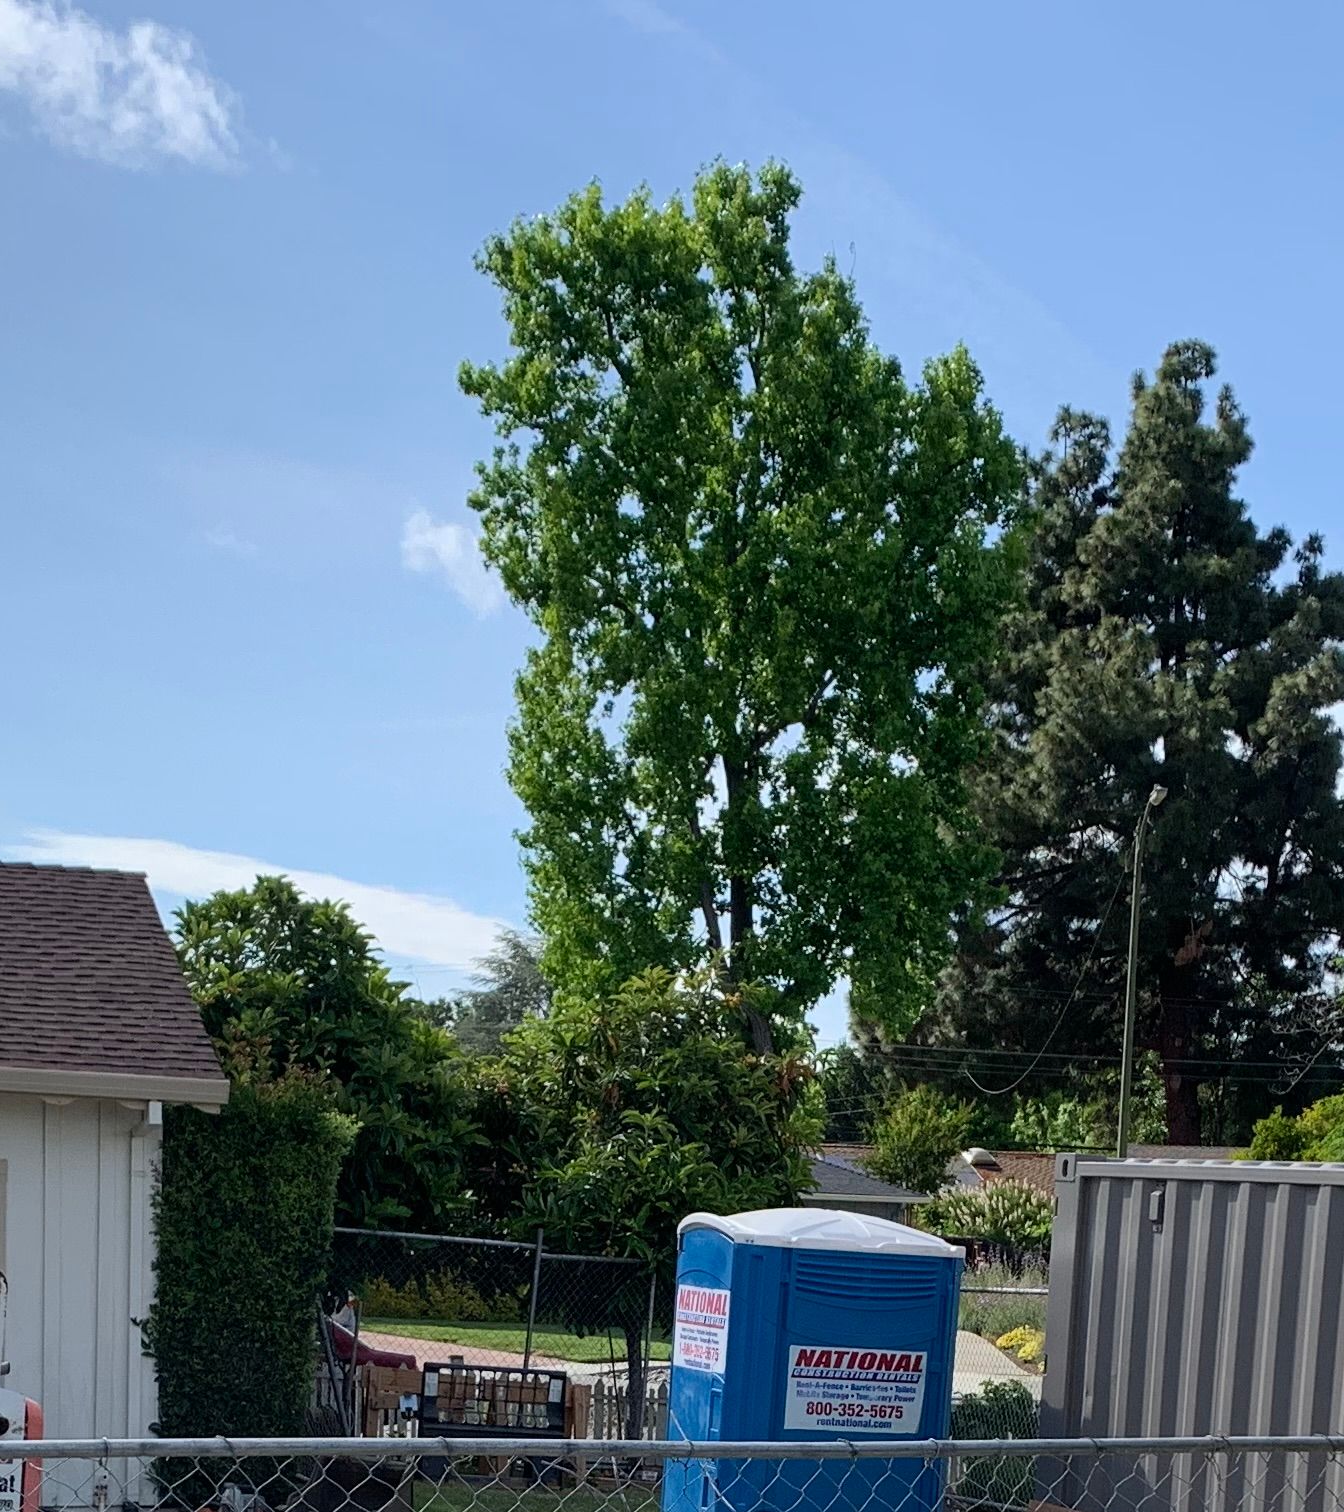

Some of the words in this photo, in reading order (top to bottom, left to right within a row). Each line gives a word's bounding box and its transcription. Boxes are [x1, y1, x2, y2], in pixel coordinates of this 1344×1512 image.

[678, 1288, 728, 1316] NATIONAL
[795, 1348, 923, 1373] NATIONAL
[793, 1367, 874, 1380] CONSTRUCTION
[876, 1371, 919, 1382] RENTALS
[806, 1401, 904, 1419] 800-352-5675
[816, 1417, 892, 1429] rentnational.com
